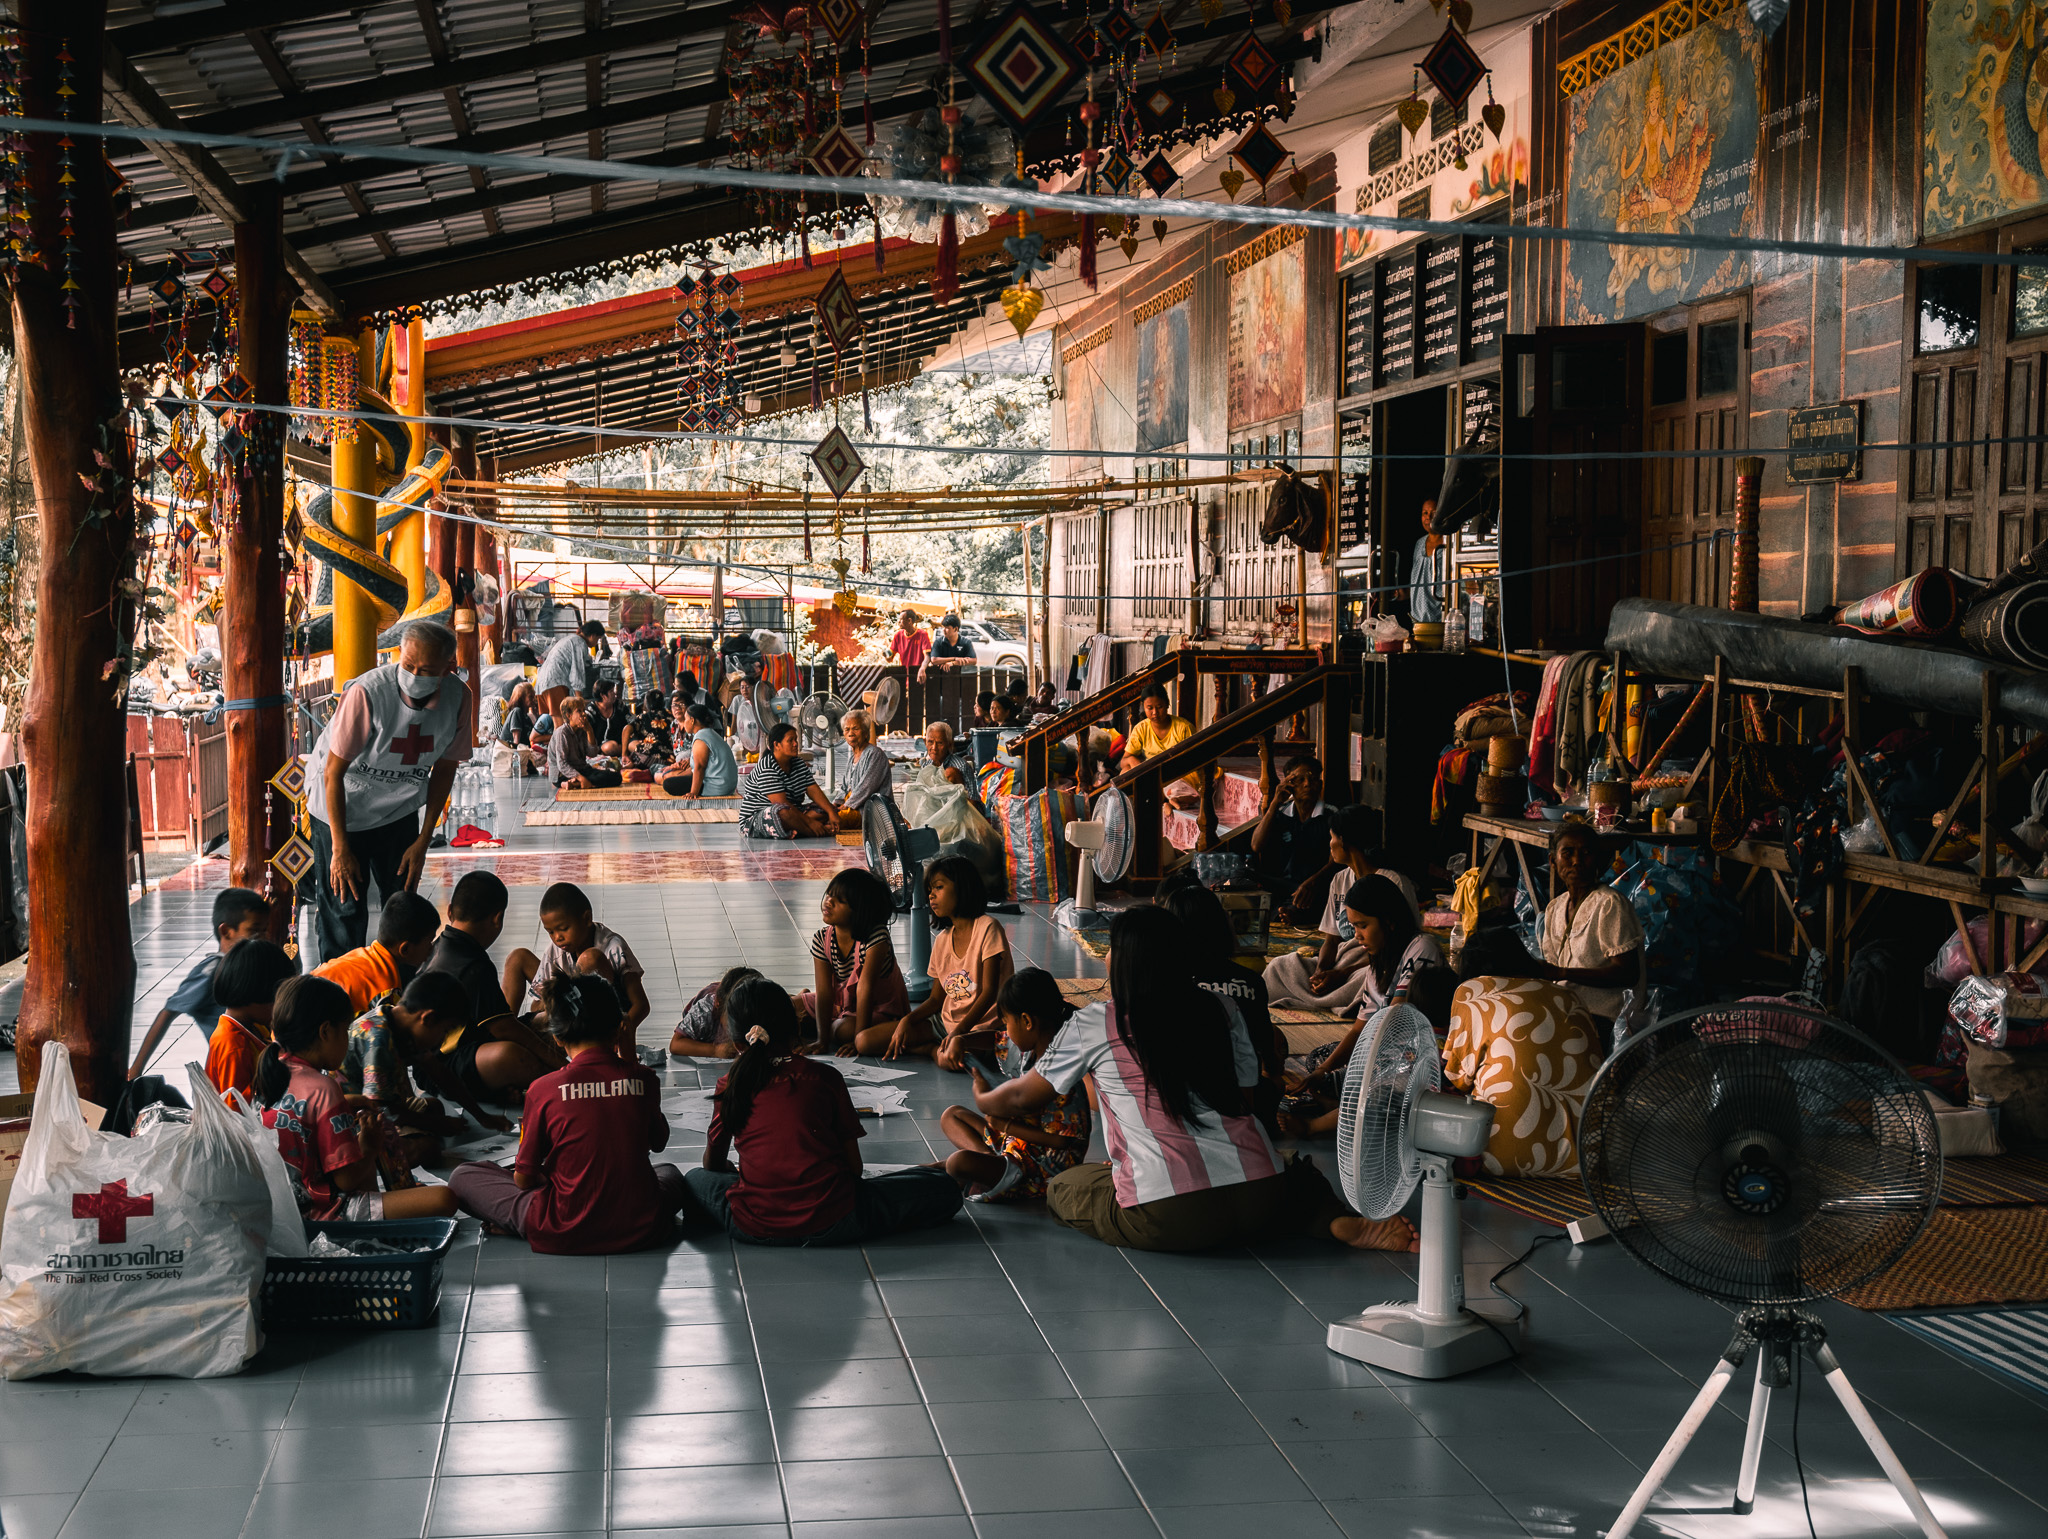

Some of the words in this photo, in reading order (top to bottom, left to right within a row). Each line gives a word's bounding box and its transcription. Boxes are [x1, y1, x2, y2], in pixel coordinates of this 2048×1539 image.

[557, 1077, 644, 1101] THAILAND
[46, 1244, 184, 1269] สภากาชาดไทย
[44, 1273, 62, 1284] The
[65, 1273, 86, 1284] Thai
[89, 1272, 109, 1283] Red
[113, 1271, 142, 1282] Cross
[146, 1269, 183, 1281] Society
